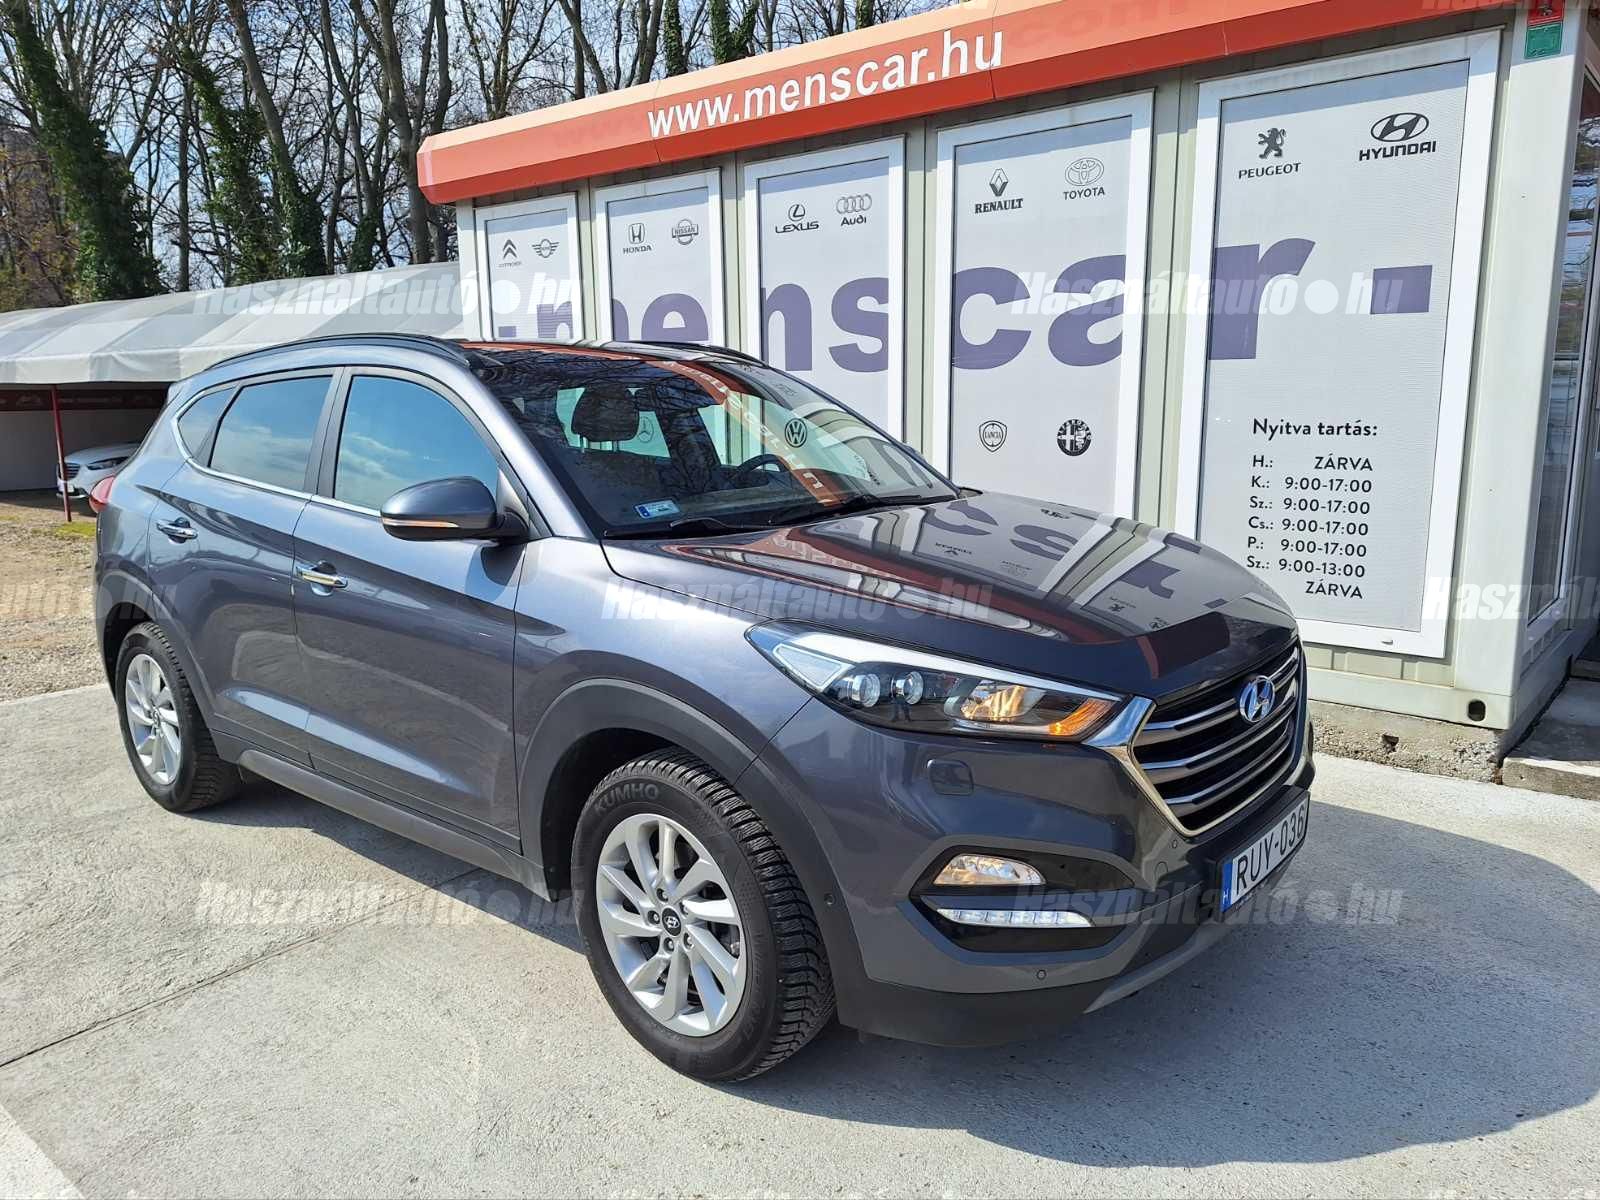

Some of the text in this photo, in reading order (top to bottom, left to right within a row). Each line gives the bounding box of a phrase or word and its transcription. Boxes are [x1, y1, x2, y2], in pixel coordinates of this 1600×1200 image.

[648, 30, 1004, 138] www.menscar.hu
[1358, 140, 1437, 162] HYUNDAI
[1238, 162, 1301, 179] PEUGEOT
[1063, 186, 1105, 200] TOYOTA
[974, 198, 1023, 214] RENAULT
[775, 221, 819, 234] LEXUS
[840, 214, 867, 226] Audi
[622, 245, 652, 254] HONDA
[1253, 418, 1378, 441] Nyitva tartás:
[1252, 453, 1373, 471] H.: ZÁRVA
[1251, 475, 1372, 493] K.: 9:00-17:00
[1250, 495, 1370, 515] Sz.: 9:00-17:00
[1248, 516, 1369, 536] Cs.: 9:00-17:00
[1247, 536, 1367, 557] P.: 9:00-17:00
[1246, 555, 1365, 578] Sz.: 9:00-13:00
[1305, 578, 1363, 599] ZÁRVA
[1236, 804, 1306, 896] RUY-036
